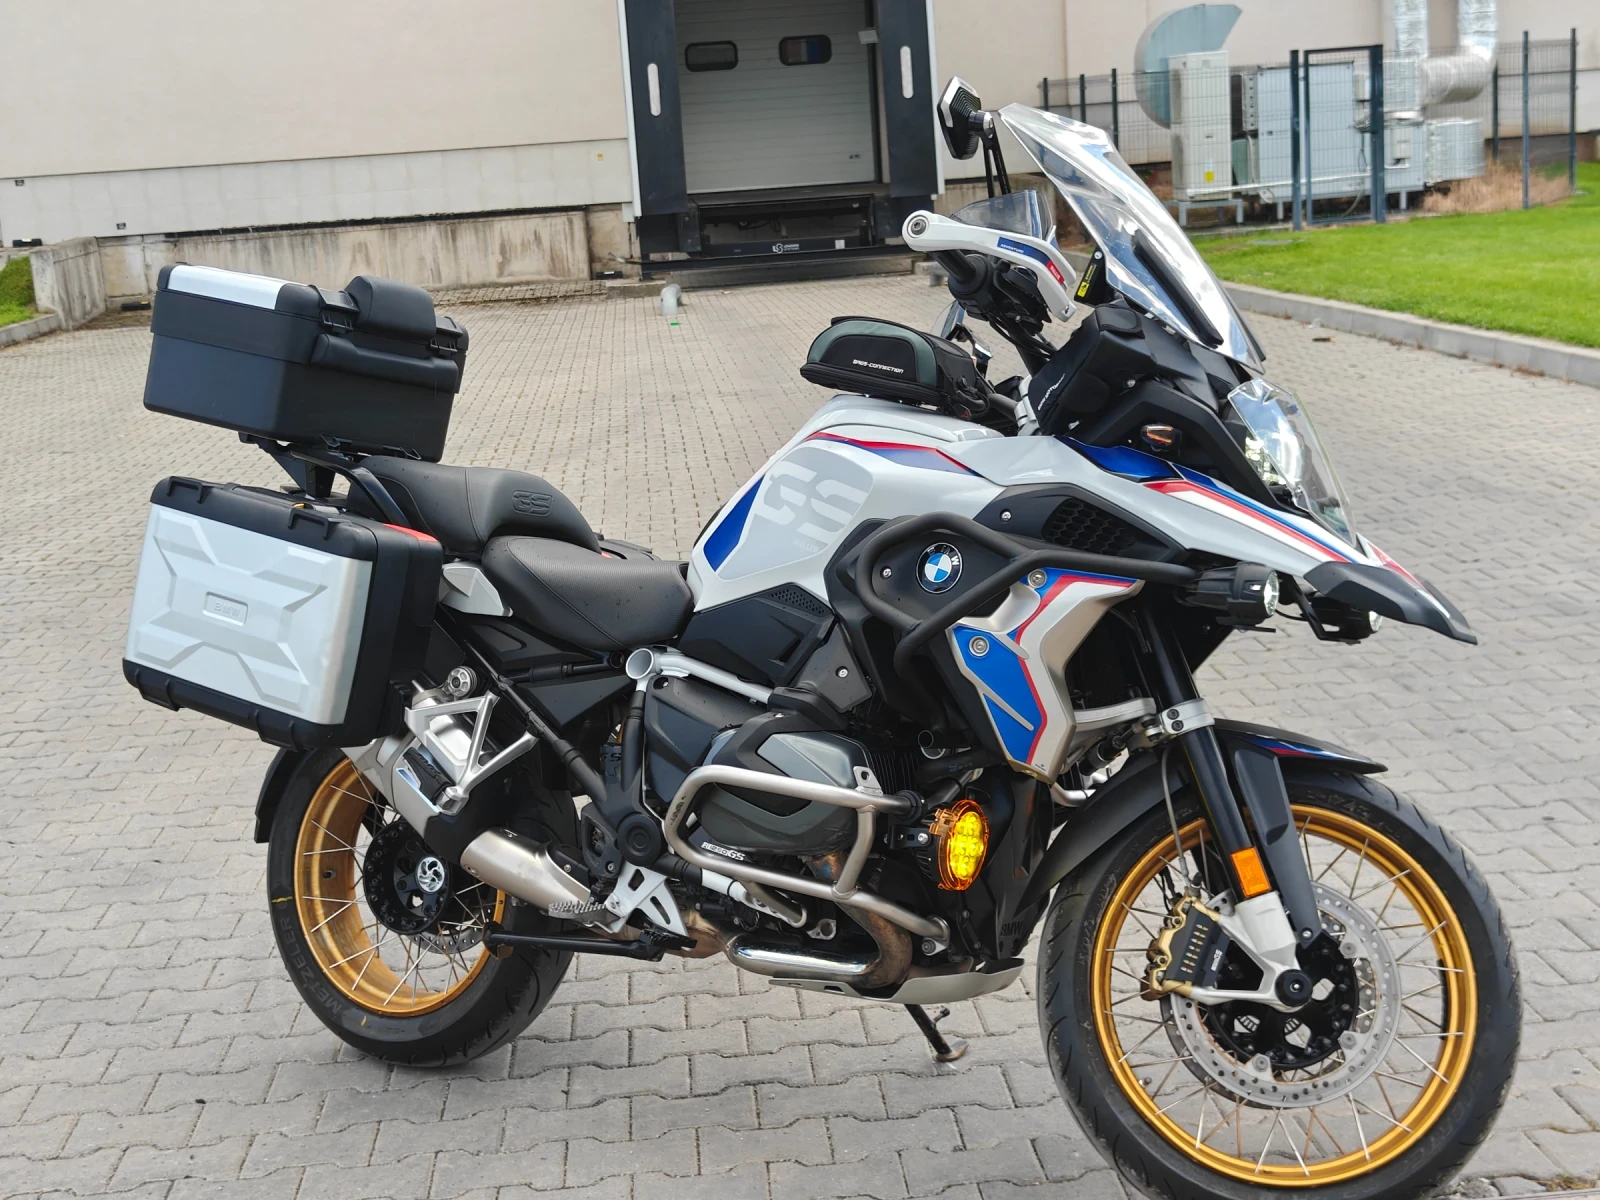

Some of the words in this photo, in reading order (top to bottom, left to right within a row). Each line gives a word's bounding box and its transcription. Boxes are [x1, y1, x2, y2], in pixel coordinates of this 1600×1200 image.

[512, 490, 552, 516] GS
[215, 601, 241, 617] BMW
[1000, 921, 1023, 937] BMW
[279, 916, 343, 1014] METZELER
